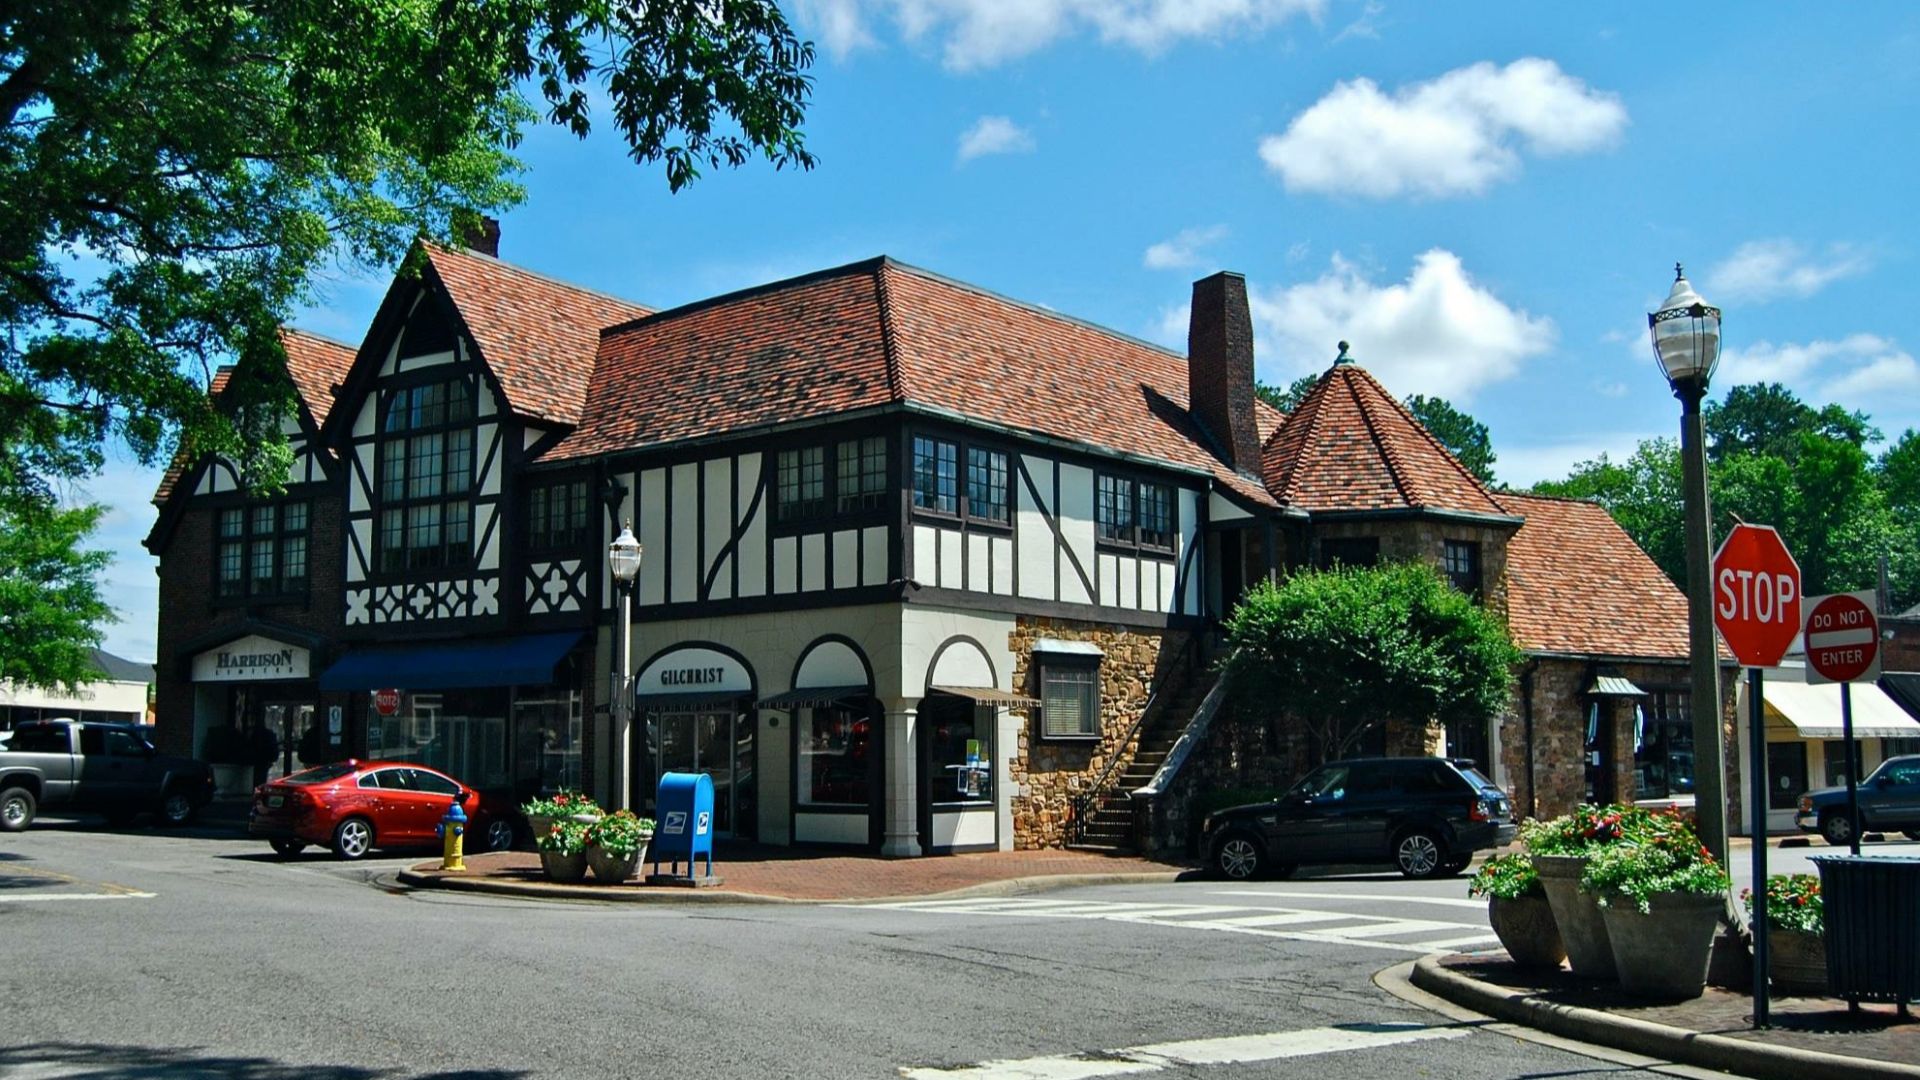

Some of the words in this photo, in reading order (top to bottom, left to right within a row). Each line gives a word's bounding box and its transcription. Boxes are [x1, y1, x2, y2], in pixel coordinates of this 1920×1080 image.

[1719, 568, 1795, 623] STOP
[1814, 613, 1832, 628] DO
[1839, 609, 1865, 625] NOT
[216, 649, 293, 668] HARRISON
[1821, 649, 1863, 666] ENTER
[661, 667, 724, 685] GILCHRIST
